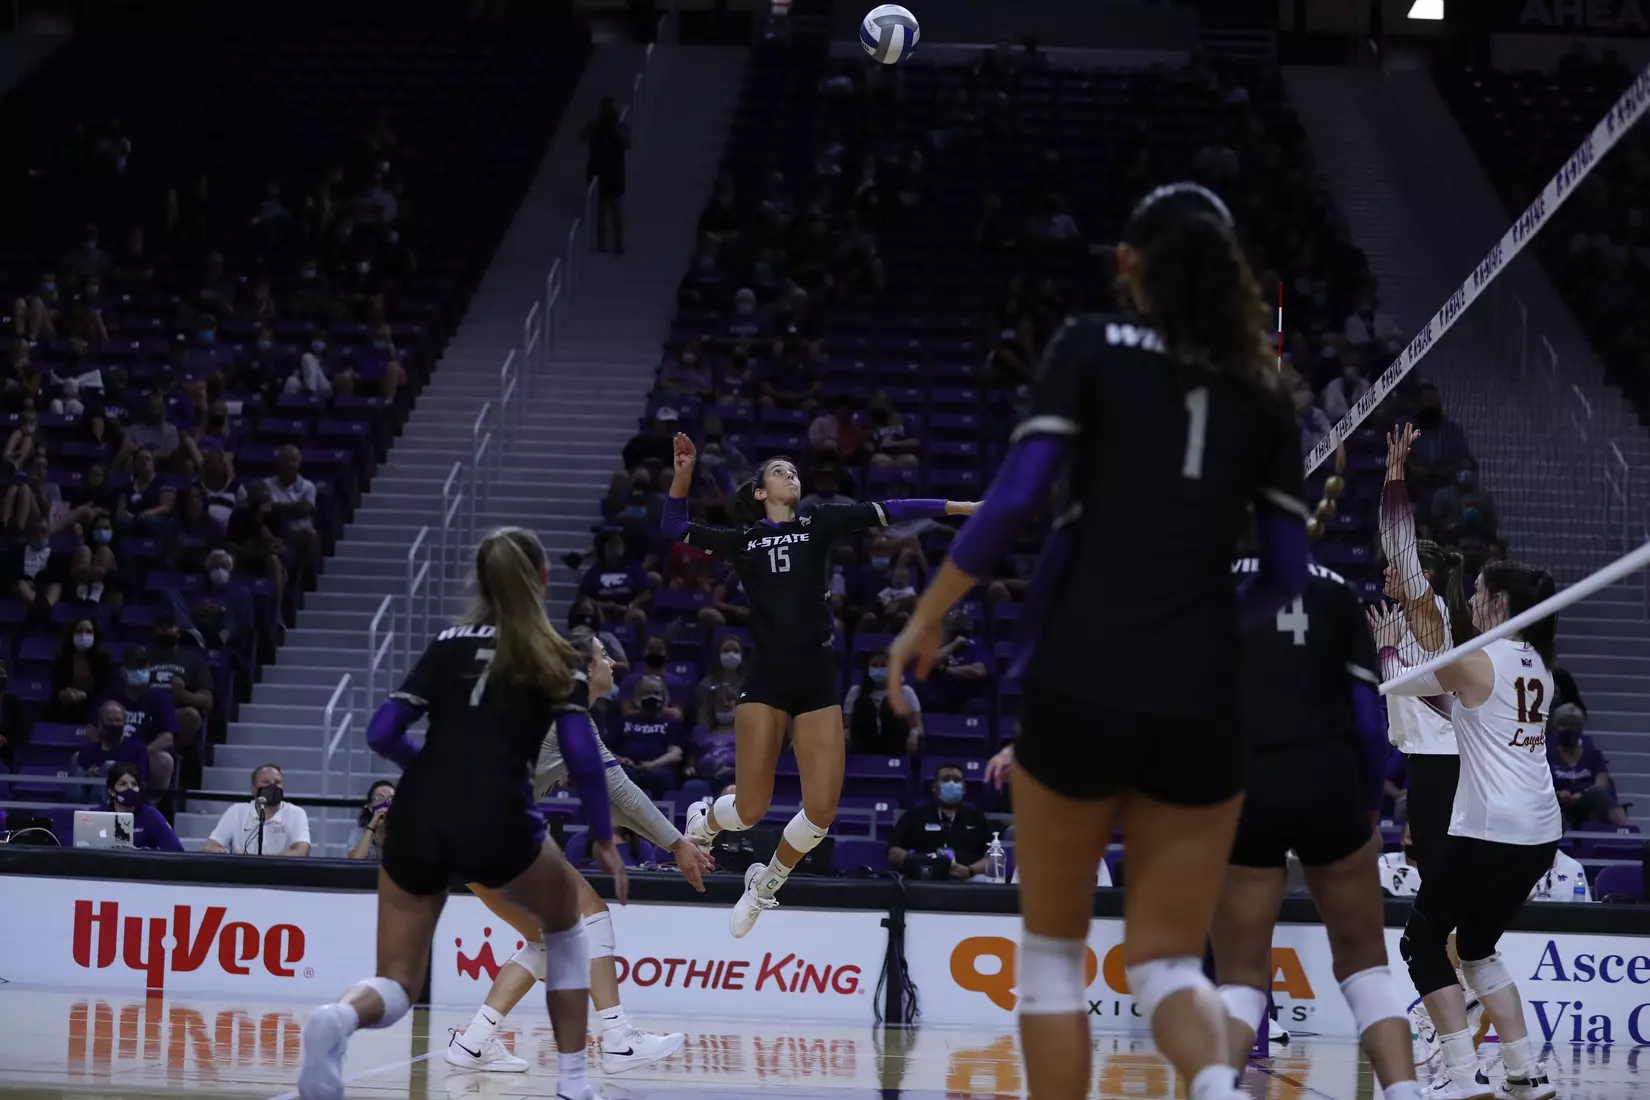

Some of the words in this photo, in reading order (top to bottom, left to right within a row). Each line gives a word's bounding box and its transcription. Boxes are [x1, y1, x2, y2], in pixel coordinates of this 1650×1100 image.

[1181, 386, 1209, 480] 1
[747, 533, 810, 551] K-STATE
[768, 545, 791, 573] 15
[1276, 595, 1309, 645] 4
[469, 648, 497, 707] 7
[1514, 677, 1544, 722] 12
[614, 956, 750, 990] OOTHIE
[1528, 1001, 1615, 1043] Via
